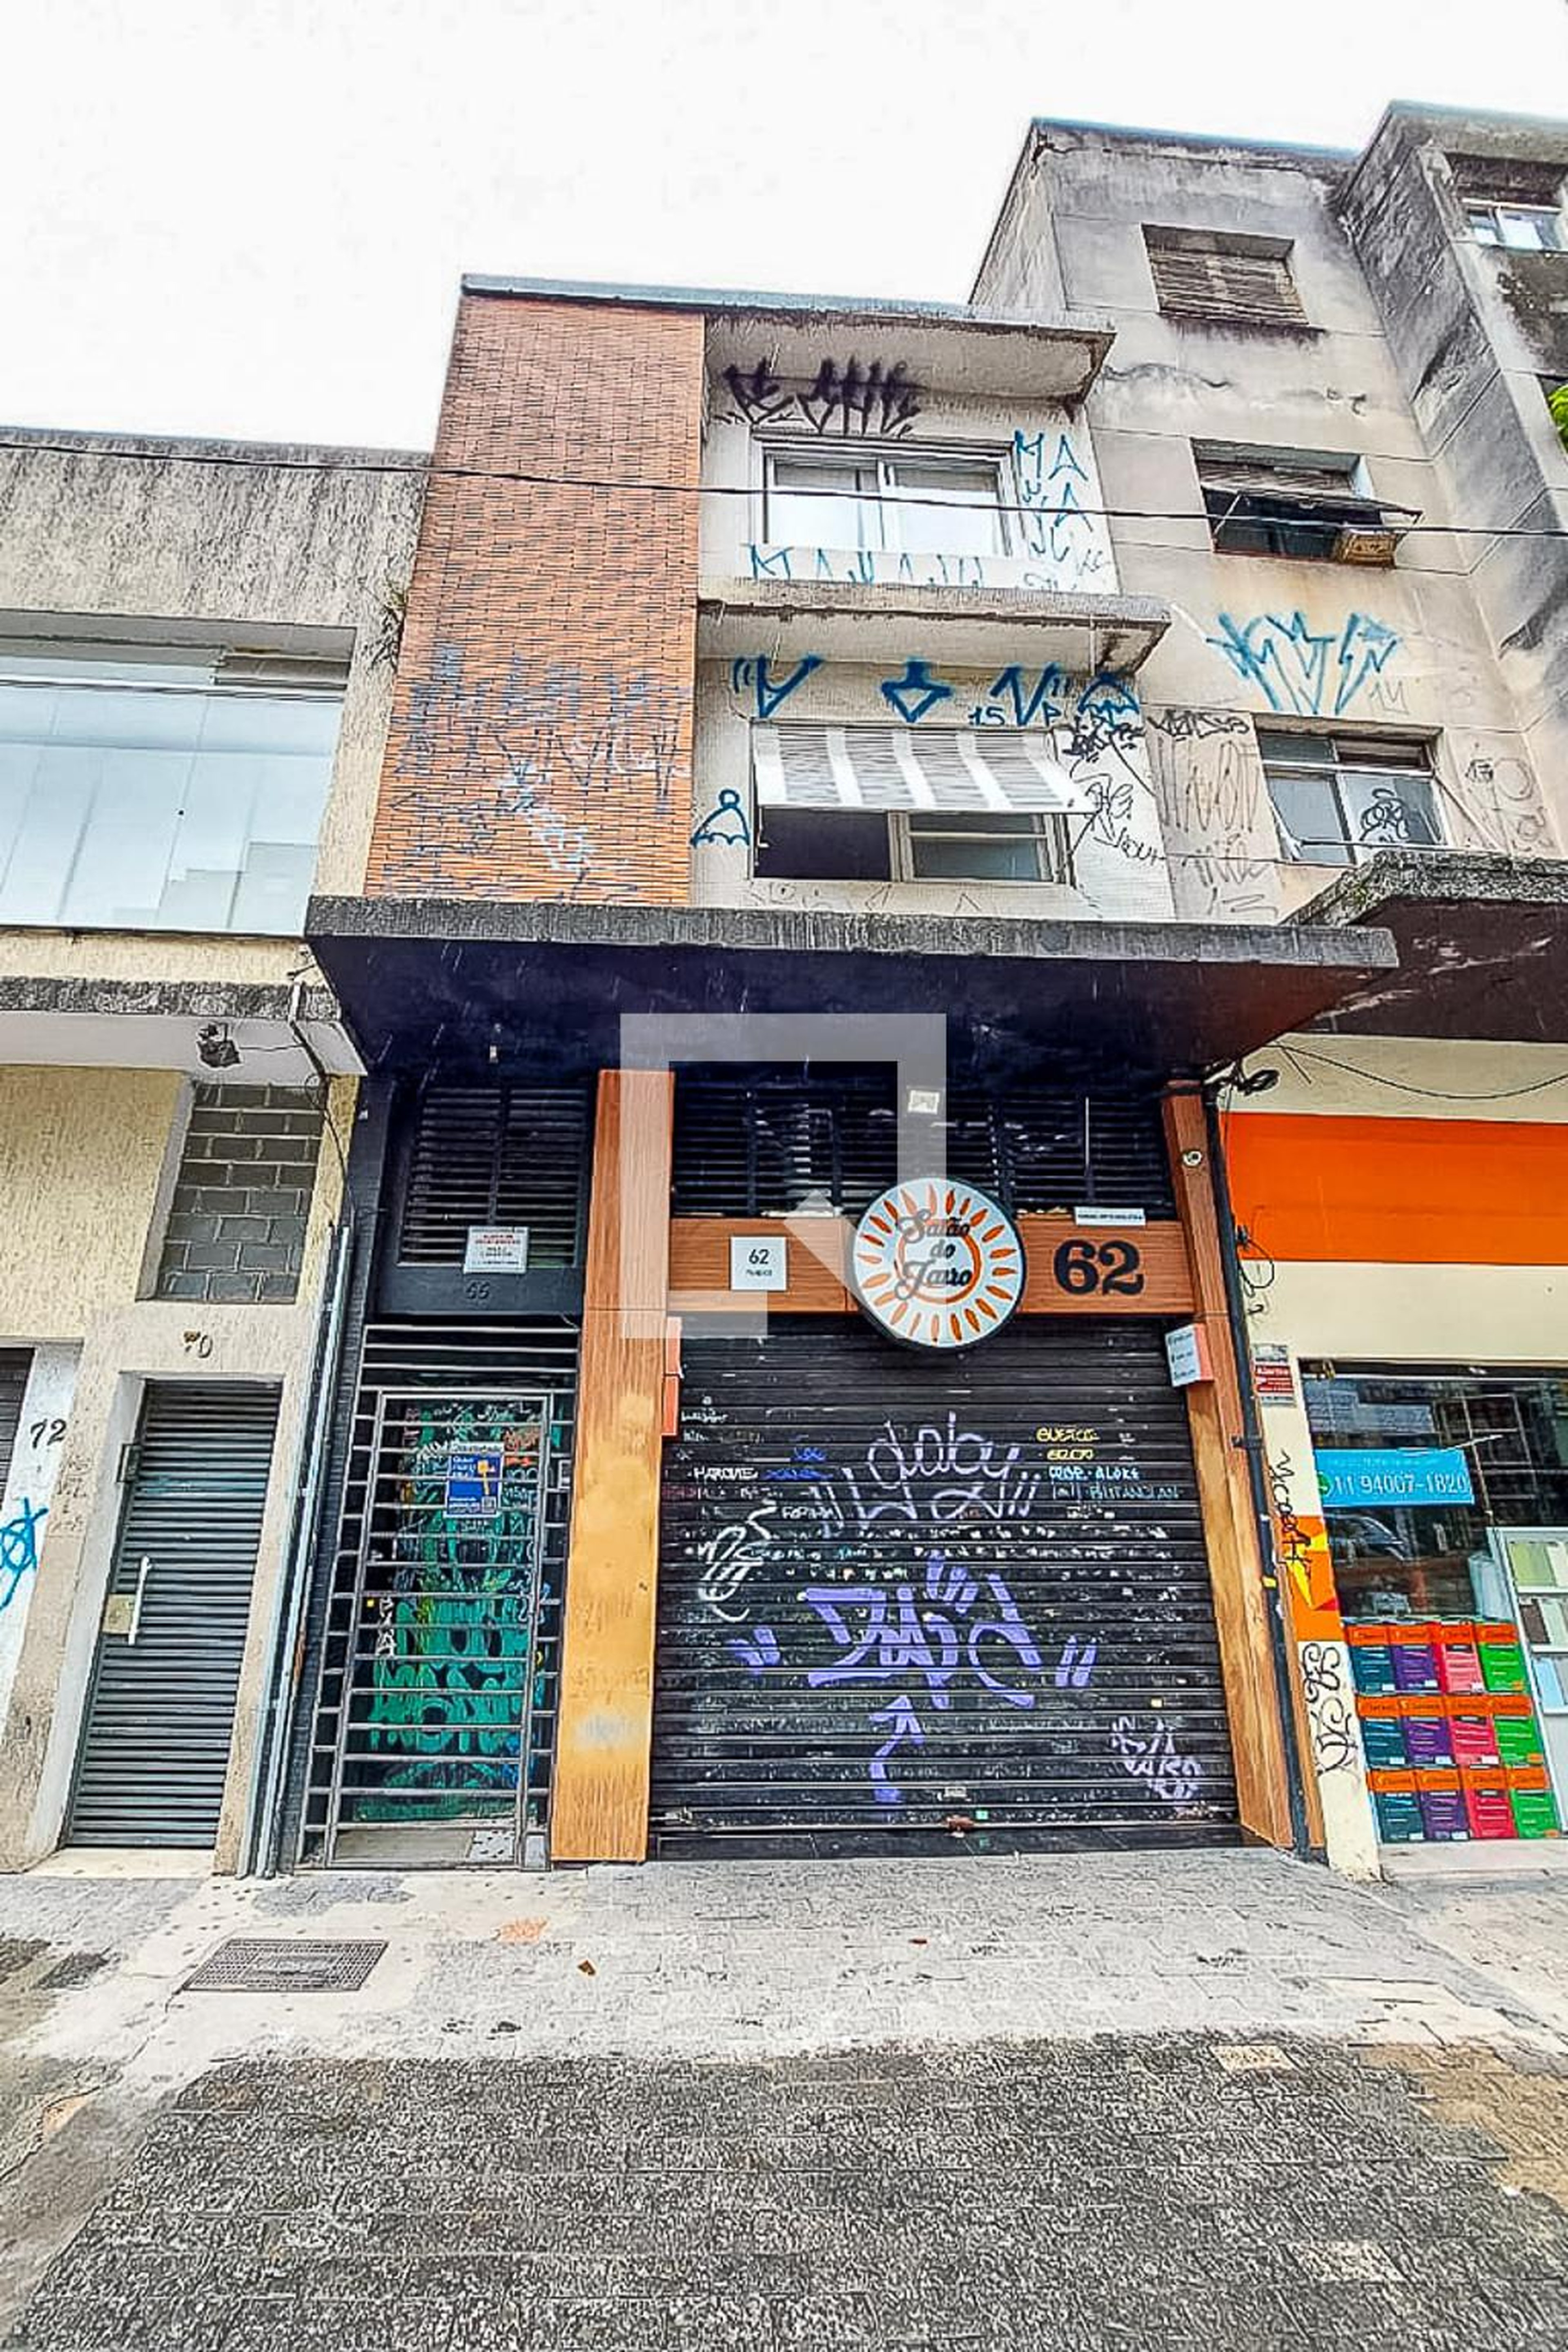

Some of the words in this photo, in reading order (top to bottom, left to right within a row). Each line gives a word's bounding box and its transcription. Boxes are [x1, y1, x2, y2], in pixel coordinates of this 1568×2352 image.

[749, 1249, 770, 1264] 62
[930, 1239, 956, 1258] do
[1054, 1239, 1144, 1296] 62
[30, 1419, 67, 1448] 72
[1335, 1475, 1354, 1494] 11
